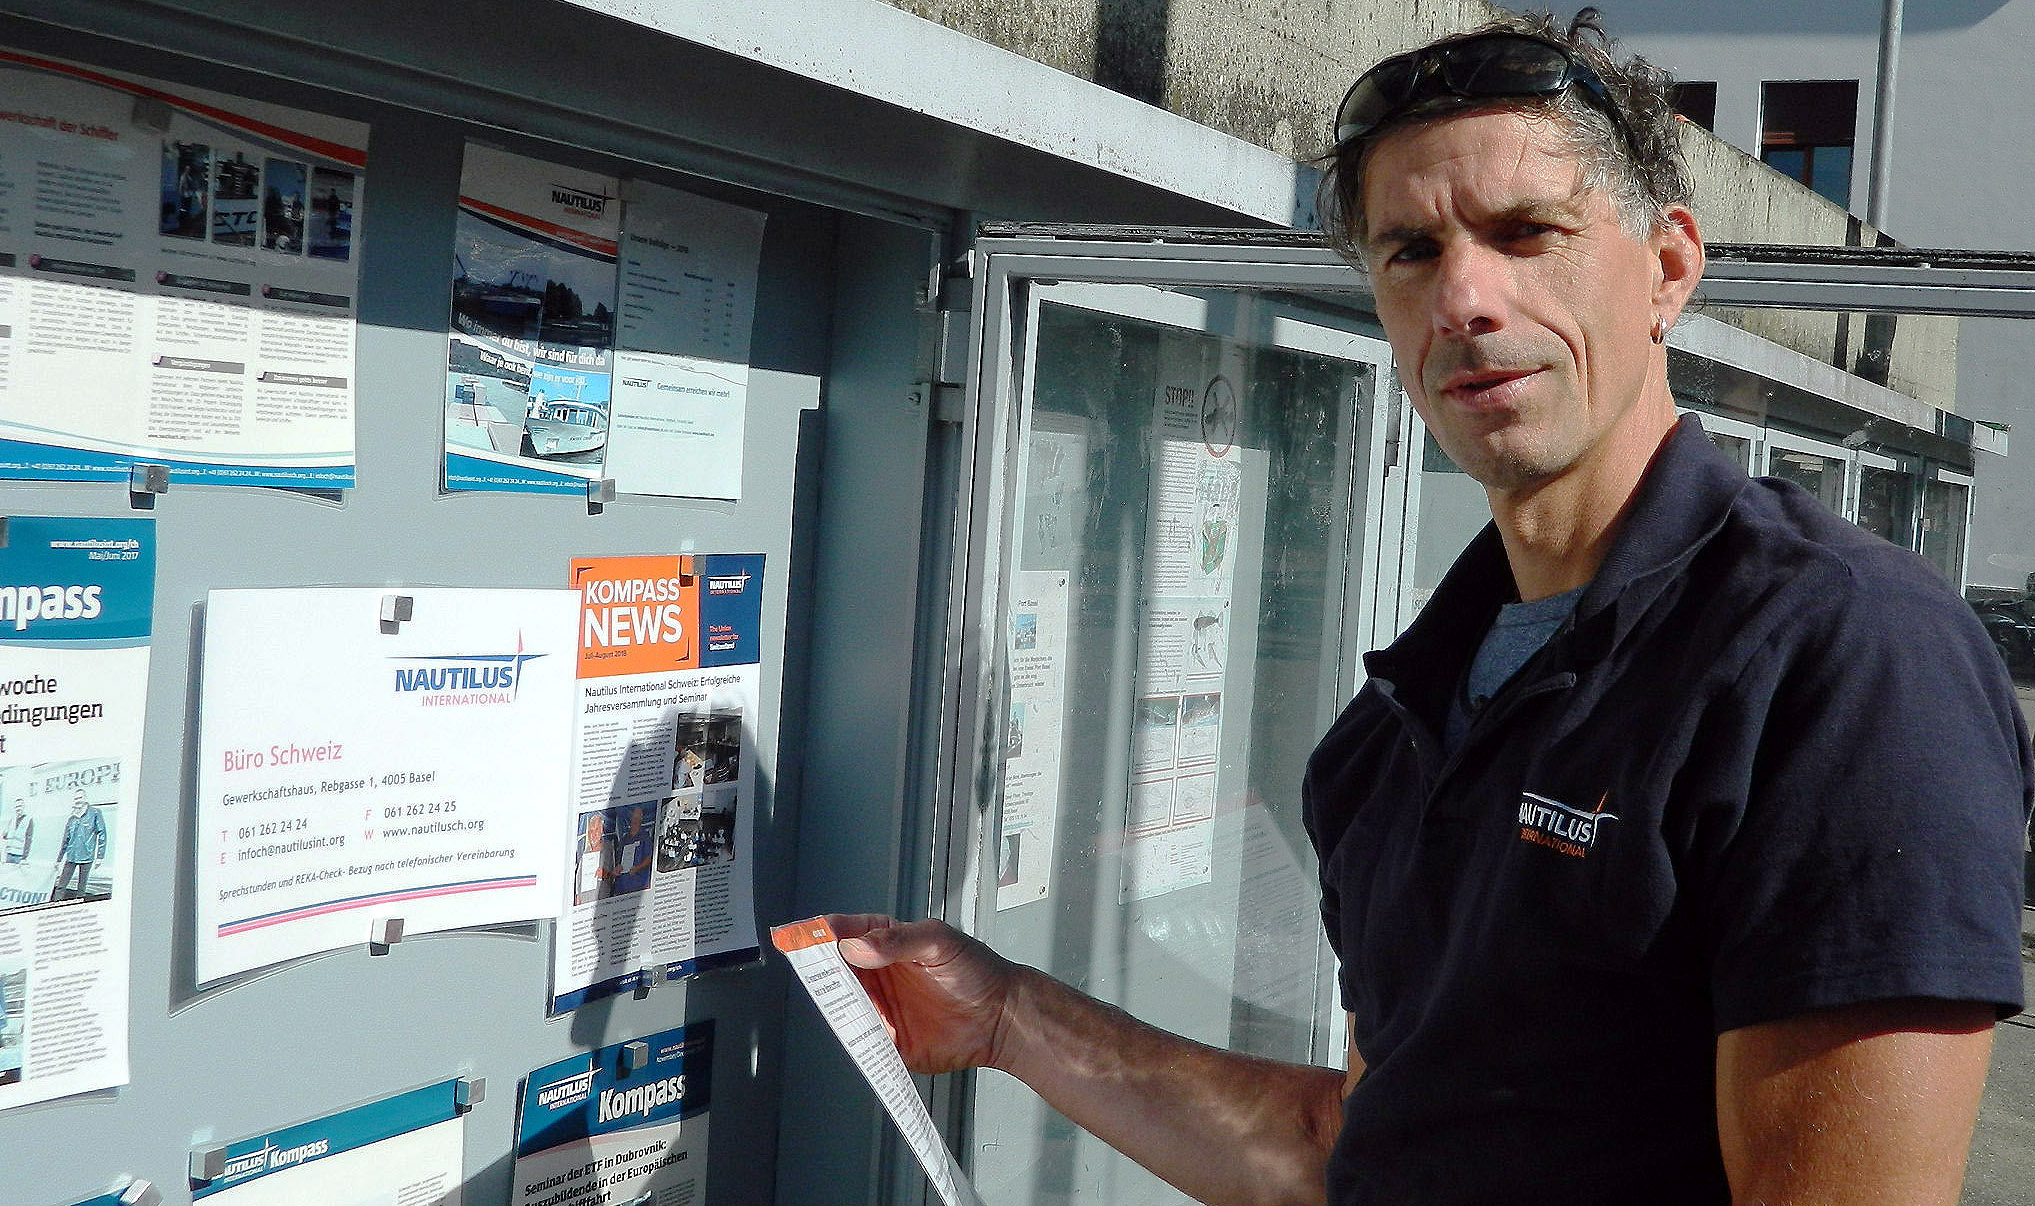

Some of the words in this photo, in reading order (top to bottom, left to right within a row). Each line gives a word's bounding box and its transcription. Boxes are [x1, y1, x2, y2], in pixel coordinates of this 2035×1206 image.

[551, 190, 602, 214] NAUTILUS
[533, 344, 548, 359] wir
[547, 348, 565, 362] sind
[565, 350, 578, 364] für
[578, 353, 595, 365] dich
[595, 354, 606, 366] da
[120, 551, 139, 561] 2017
[585, 578, 681, 605] KOMPASS
[709, 580, 742, 590] NAUTILUS
[584, 604, 683, 648] NEWS
[395, 667, 513, 692] NAUTILUS
[585, 686, 618, 698] Nautilus
[619, 680, 667, 695] International
[667, 677, 699, 690] Schweiz:
[699, 674, 741, 687] Erfolgreiche
[421, 692, 511, 707] INTERNATIONAL
[584, 697, 662, 714] Jahresversammlung
[663, 695, 678, 706] und
[678, 693, 708, 704] Seminar
[224, 748, 264, 772] Büro
[270, 740, 343, 767] Schweiz
[222, 785, 317, 806] Gewerkschaftshaus,
[321, 779, 365, 793] Rebgasse
[369, 776, 378, 789] 1,
[381, 773, 406, 786] 4005
[409, 770, 436, 783] Basel
[365, 809, 372, 821] F
[384, 807, 401, 819] 061
[406, 803, 425, 816] 262
[428, 802, 440, 813] 24
[444, 801, 457, 812] 25
[1518, 802, 1592, 843] AUTILUS
[221, 830, 228, 842] T
[238, 826, 256, 839] 061
[260, 822, 277, 836] 262
[280, 820, 292, 833] 24
[295, 818, 308, 831] 24
[364, 829, 374, 840] W
[383, 819, 485, 838] www.nautilusch.org
[220, 852, 226, 864] E
[238, 835, 345, 861] infoch@nautilusint.org
[219, 880, 277, 901] Sprechstunden
[278, 876, 294, 888] und
[348, 864, 373, 876] Bezug
[374, 860, 395, 872] nach
[397, 853, 454, 870] telefonischer
[457, 848, 515, 862] Vereinbarung
[538, 1078, 588, 1106] NAUTILUS
[599, 1075, 686, 1123] Kompass
[270, 1139, 328, 1168] Kompass
[525, 1173, 566, 1196] Seminar
[567, 1168, 585, 1182] der
[585, 1159, 603, 1175] ETF
[604, 1156, 613, 1169] in
[616, 1140, 667, 1166] Dubrovnik:
[525, 1181, 598, 1206] uszubildende
[598, 1177, 608, 1189] in
[609, 1171, 625, 1186] der
[627, 1150, 688, 1179] Europäischen
